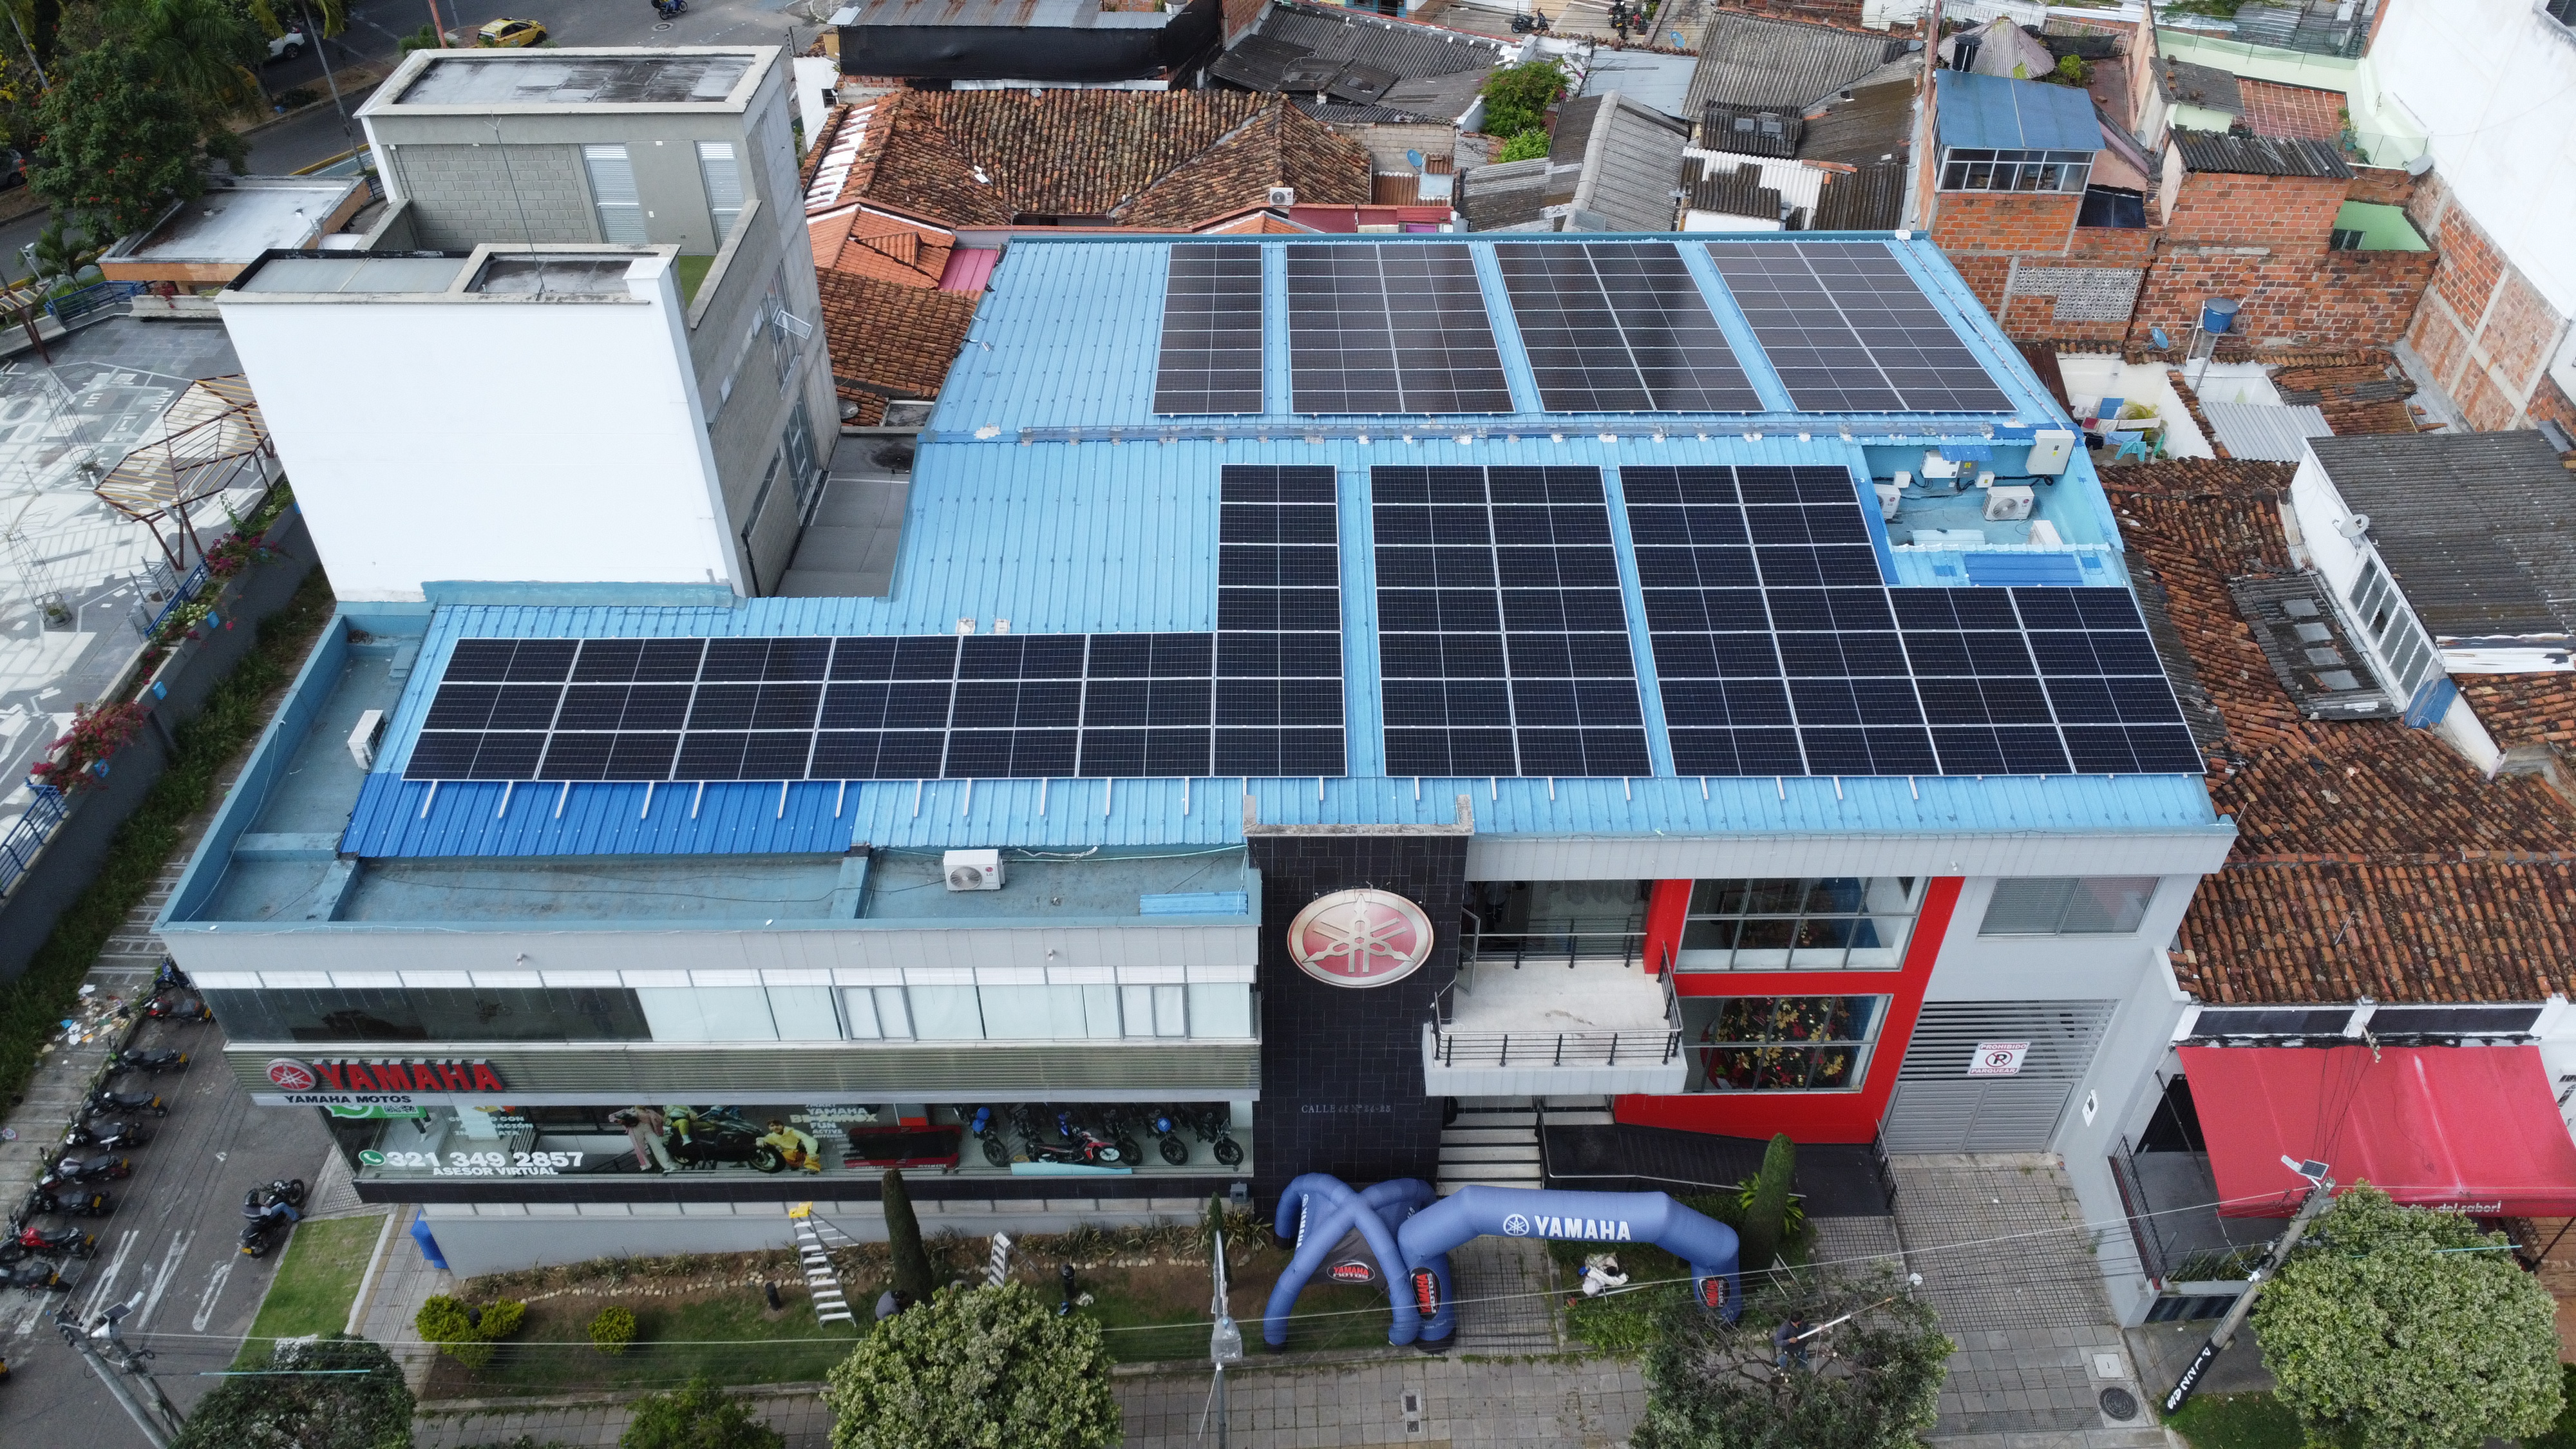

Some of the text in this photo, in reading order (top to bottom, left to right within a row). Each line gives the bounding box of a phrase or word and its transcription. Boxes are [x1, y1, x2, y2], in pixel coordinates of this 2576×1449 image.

[312, 1059, 504, 1090] YAMAHA
[284, 1095, 412, 1104] YAMAHA MOTOS
[1301, 1104, 1336, 1113] CALLE
[386, 1151, 584, 1167] 321 349 2857
[433, 1167, 559, 1175] ASESOR VIRTUAL
[2438, 1202, 2458, 1213] del
[2461, 1200, 2502, 1213] sabor!
[1534, 1215, 1632, 1240] YAMAHA
[1334, 1266, 1369, 1276] YAMAHA
[1417, 1273, 1432, 1313] YAMAHA
[2167, 1347, 2211, 1410] PIZZAS
